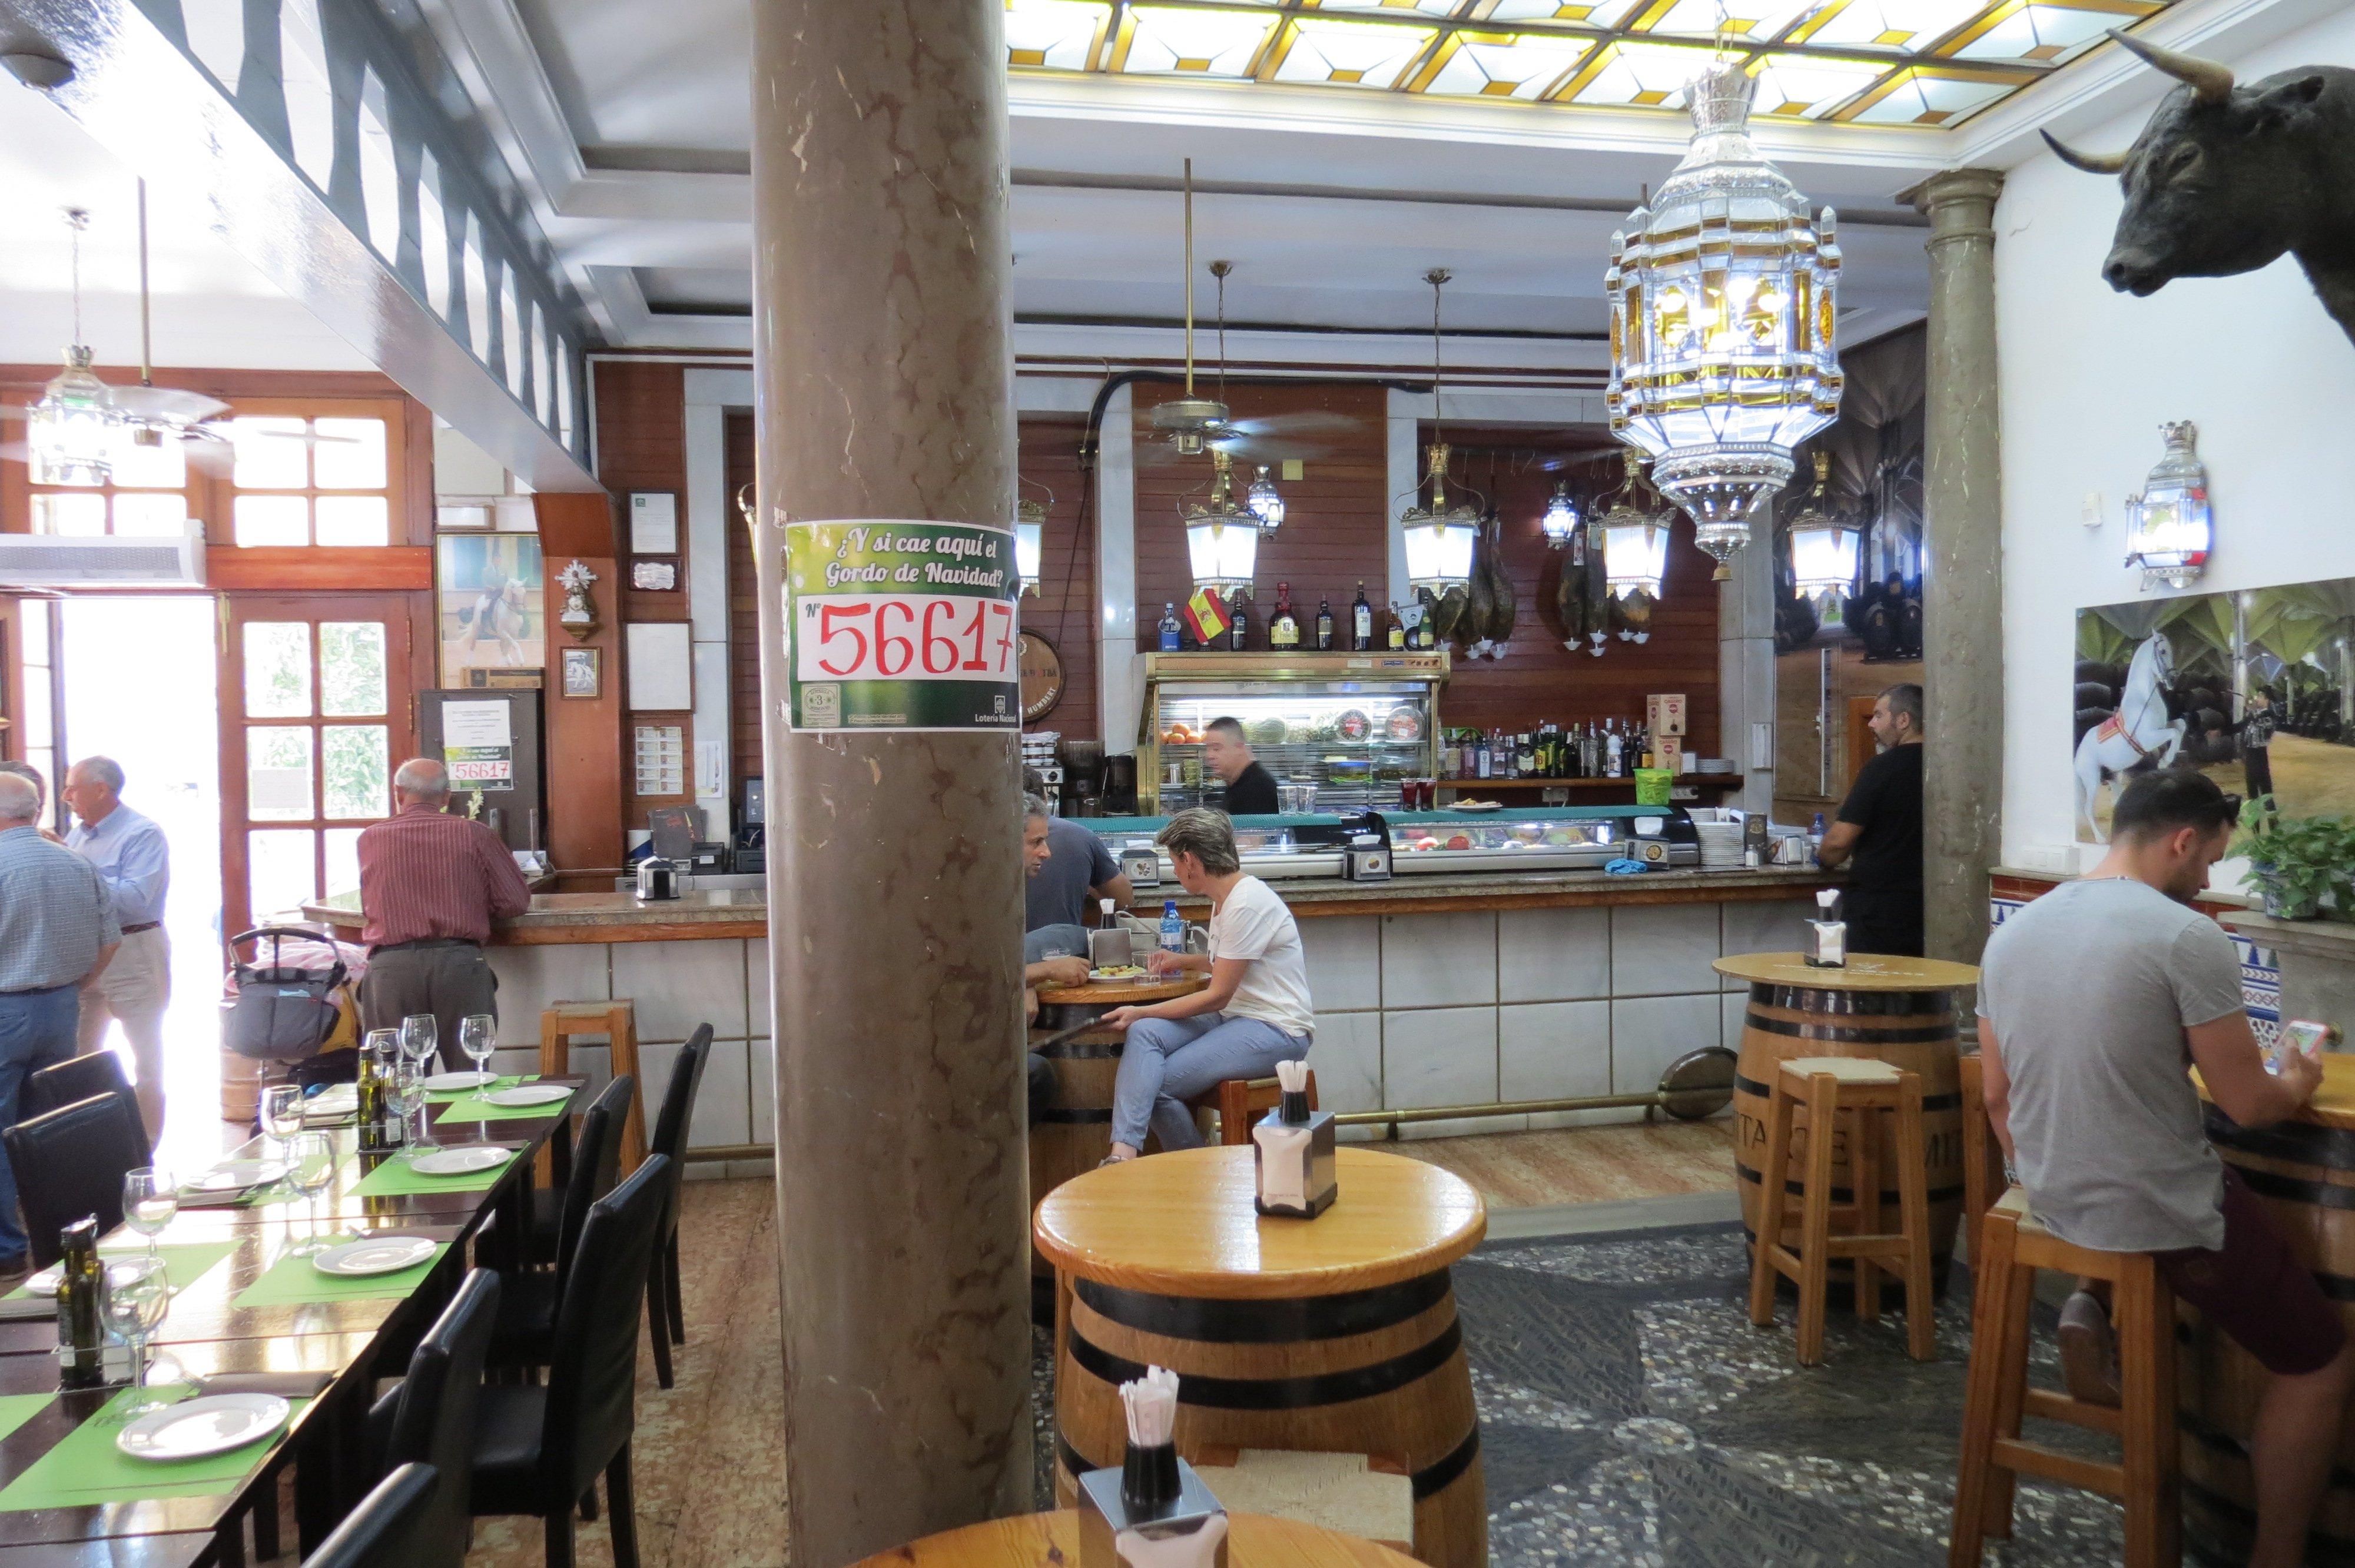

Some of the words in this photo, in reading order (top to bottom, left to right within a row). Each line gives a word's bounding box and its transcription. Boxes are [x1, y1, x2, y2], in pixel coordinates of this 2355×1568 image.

[836, 527, 871, 559] ¿Y
[873, 534, 893, 552] si
[895, 536, 930, 553] cae
[934, 533, 985, 562] aquí
[985, 540, 997, 559] el
[825, 562, 888, 589] Gordo
[894, 562, 918, 583] de
[924, 562, 1004, 589] Navidad?
[818, 600, 1014, 676] 56617
[455, 762, 509, 780] 56617
